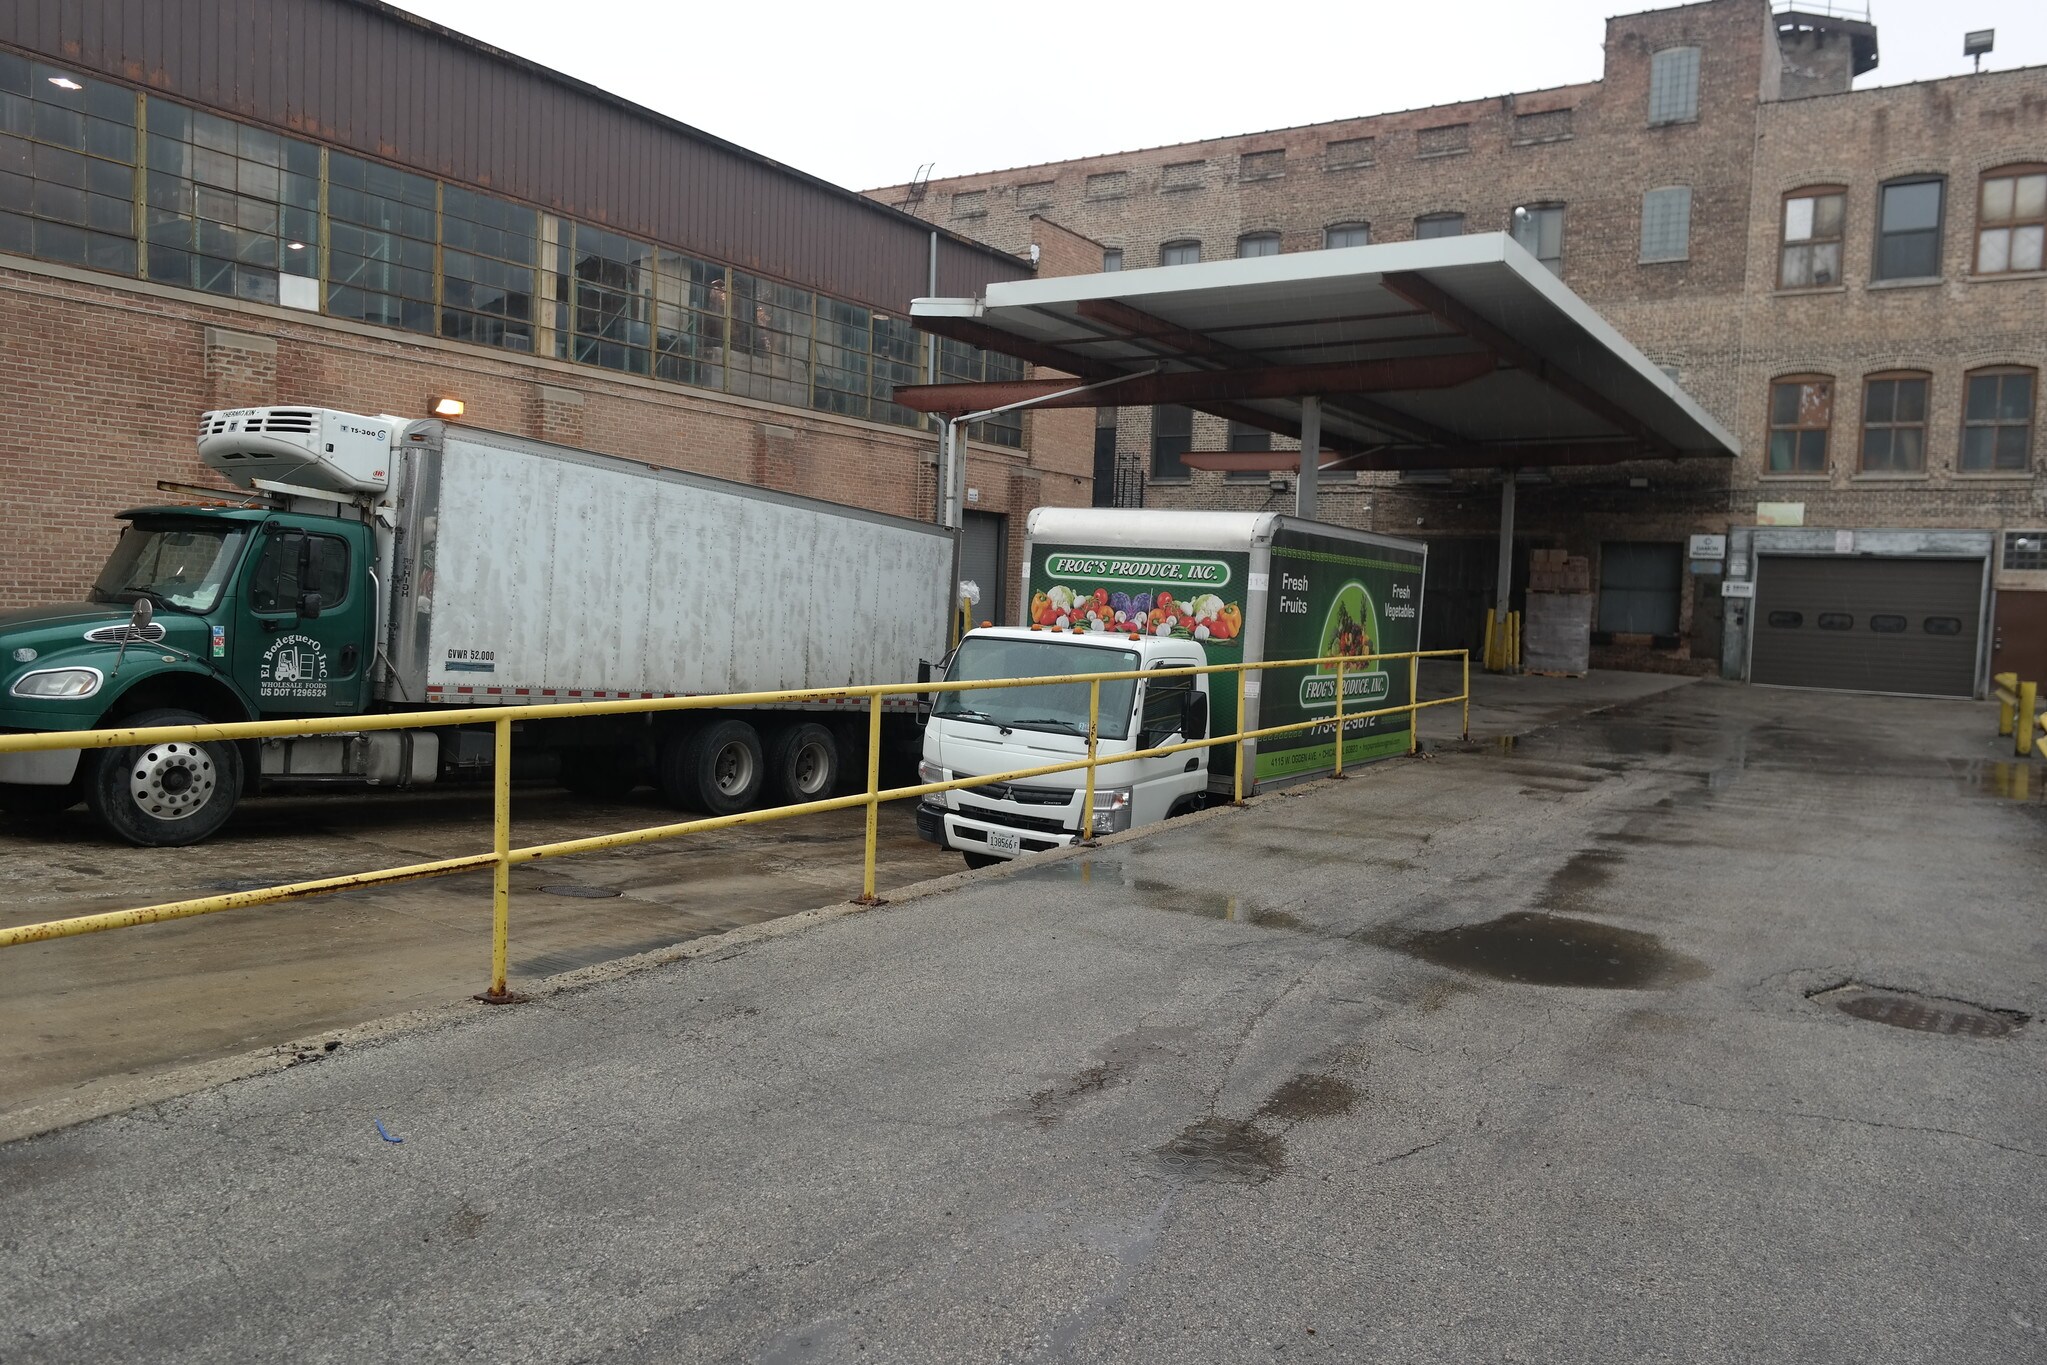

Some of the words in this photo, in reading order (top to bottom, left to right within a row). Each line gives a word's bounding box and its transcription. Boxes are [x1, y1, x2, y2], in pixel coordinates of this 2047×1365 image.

[351, 427, 376, 437] TS-300
[1056, 558, 1107, 575] FROG'S
[1109, 561, 1183, 580] PRODUCE,
[1187, 565, 1218, 581] INC.
[1281, 572, 1309, 592] Fresh
[1392, 583, 1411, 599] Fresh
[1279, 595, 1308, 614] Fruits
[1384, 602, 1415, 621] Vegetables
[447, 648, 468, 659] GVWR
[260, 688, 272, 696] US
[273, 688, 291, 696] DOT
[292, 688, 327, 697] 1296524
[1305, 680, 1335, 699] FROG'S
[1370, 677, 1384, 692] INC.
[1271, 756, 1285, 766] 4115
[990, 836, 1013, 849] 138566
